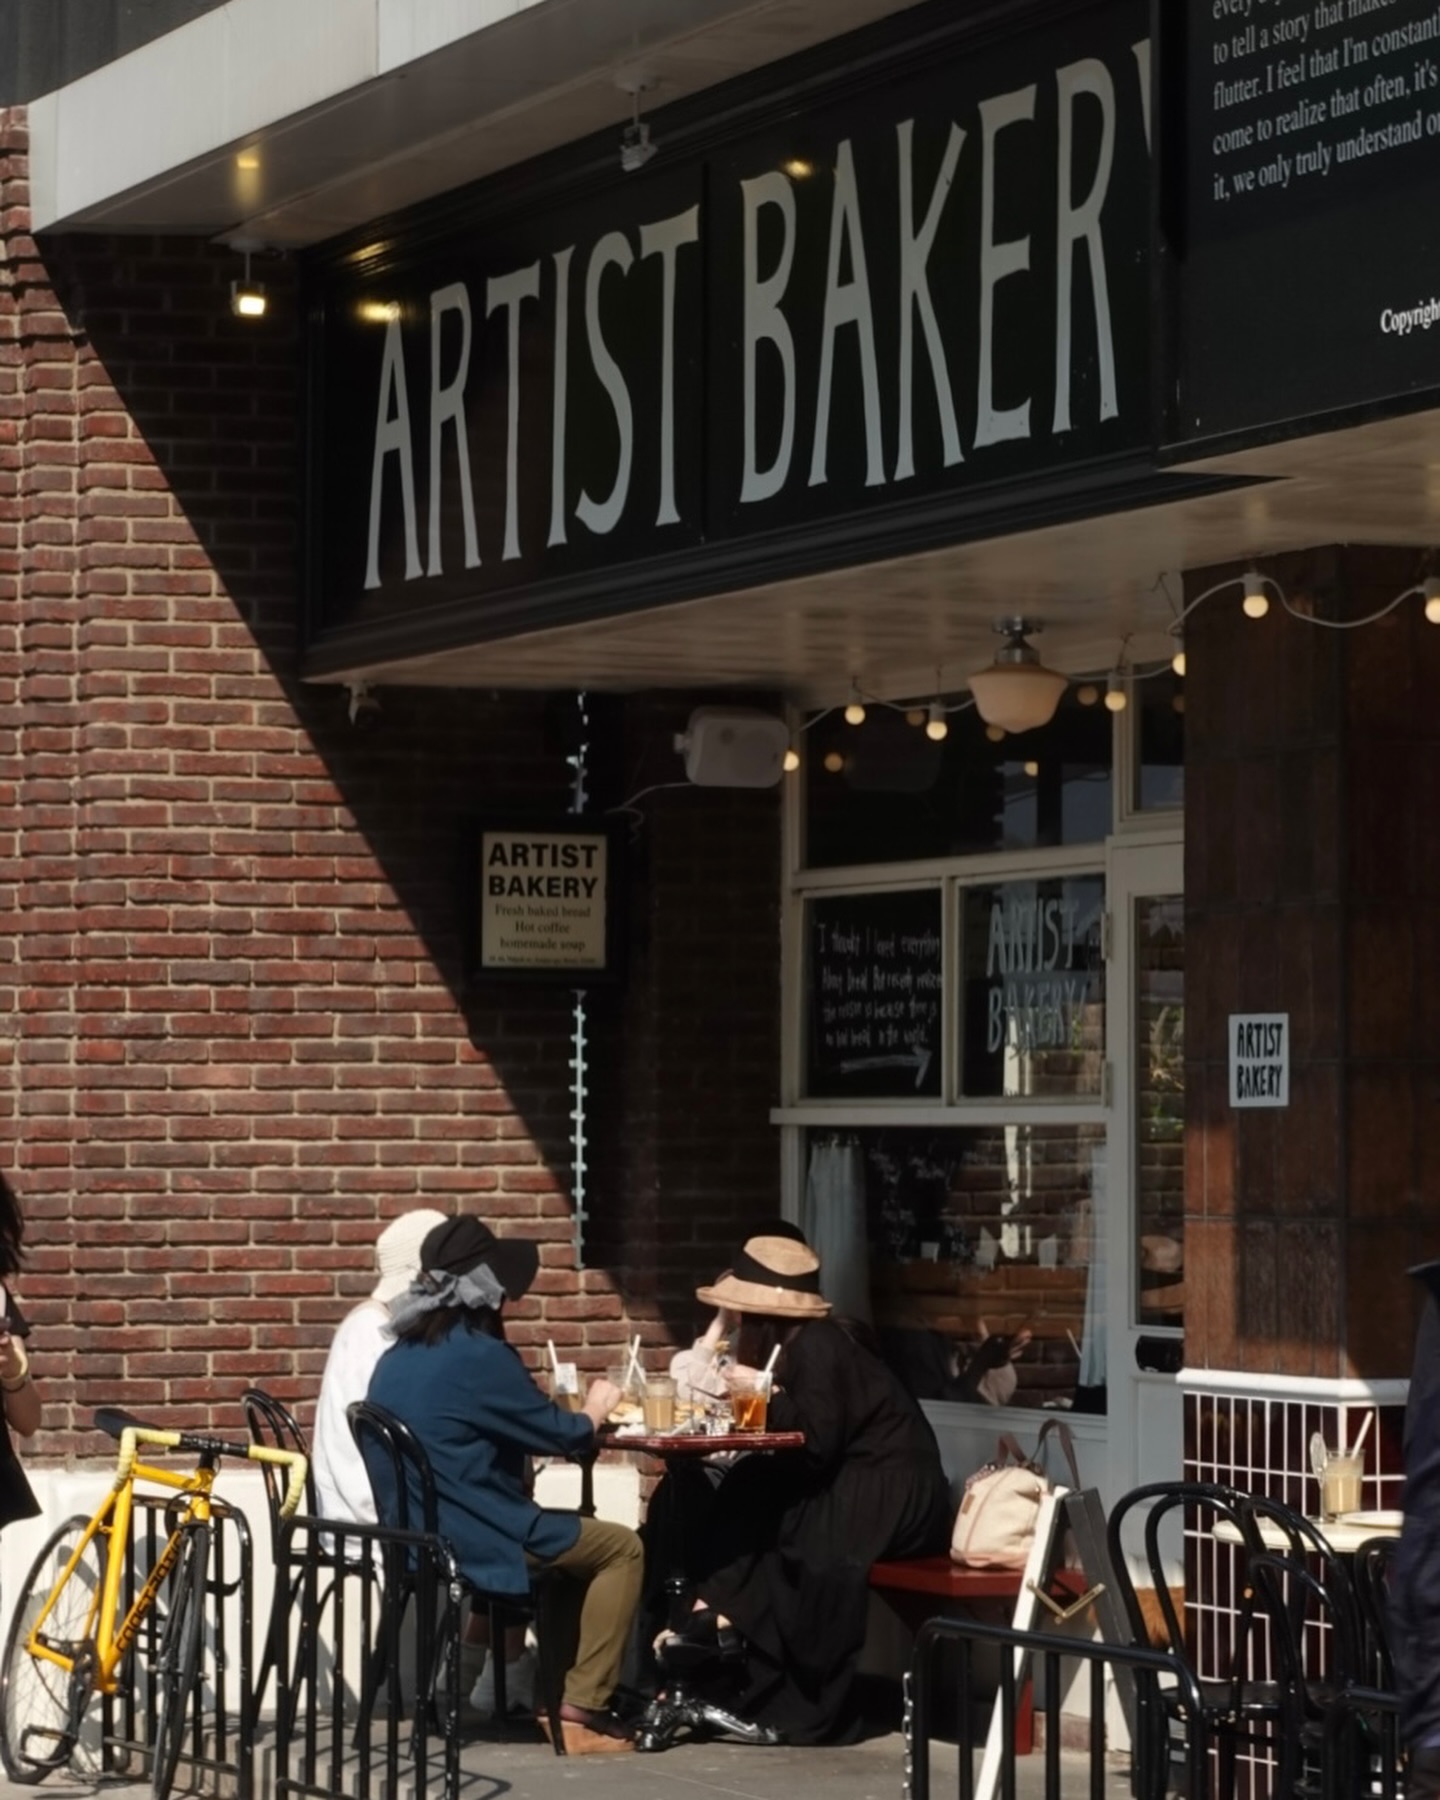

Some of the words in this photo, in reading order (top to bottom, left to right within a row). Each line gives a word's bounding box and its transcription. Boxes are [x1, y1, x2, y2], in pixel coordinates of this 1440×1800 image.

[1213, 41, 1229, 65] to
[1231, 24, 1256, 58] tell
[1259, 28, 1270, 49] a
[1272, 13, 1310, 43] story
[1314, 0, 1344, 30] that
[1213, 79, 1263, 111] flutter.
[1267, 64, 1274, 93] I
[1277, 53, 1306, 89] feel
[1309, 48, 1339, 78] that
[1343, 36, 1368, 67] I'm
[1212, 125, 1253, 155] come
[1257, 118, 1272, 142] to
[1275, 98, 1327, 137] realize
[1330, 88, 1360, 119] that
[1363, 74, 1411, 107] often,
[1414, 58, 1438, 92] it's
[1213, 172, 1230, 202] it,
[1233, 170, 1255, 193] we
[1257, 153, 1293, 188] only
[1296, 141, 1332, 177] truly
[1336, 109, 1422, 163] understand
[364, 204, 700, 590] ARTIST
[739, 40, 1152, 505] BAKER
[488, 842, 598, 868] ARTIST
[488, 875, 598, 898] BAKERY
[495, 904, 524, 916] Fresh
[527, 905, 558, 917] baked
[562, 906, 591, 917] bread
[500, 937, 557, 949] homemade
[560, 940, 585, 952] soup
[515, 921, 535, 933] Hot
[537, 922, 570, 933] coffee
[986, 898, 1079, 978] ARTIST
[987, 978, 1077, 1053] BAKERY
[1237, 1022, 1283, 1058] ARTIST
[1237, 1064, 1283, 1100] BAKERY
